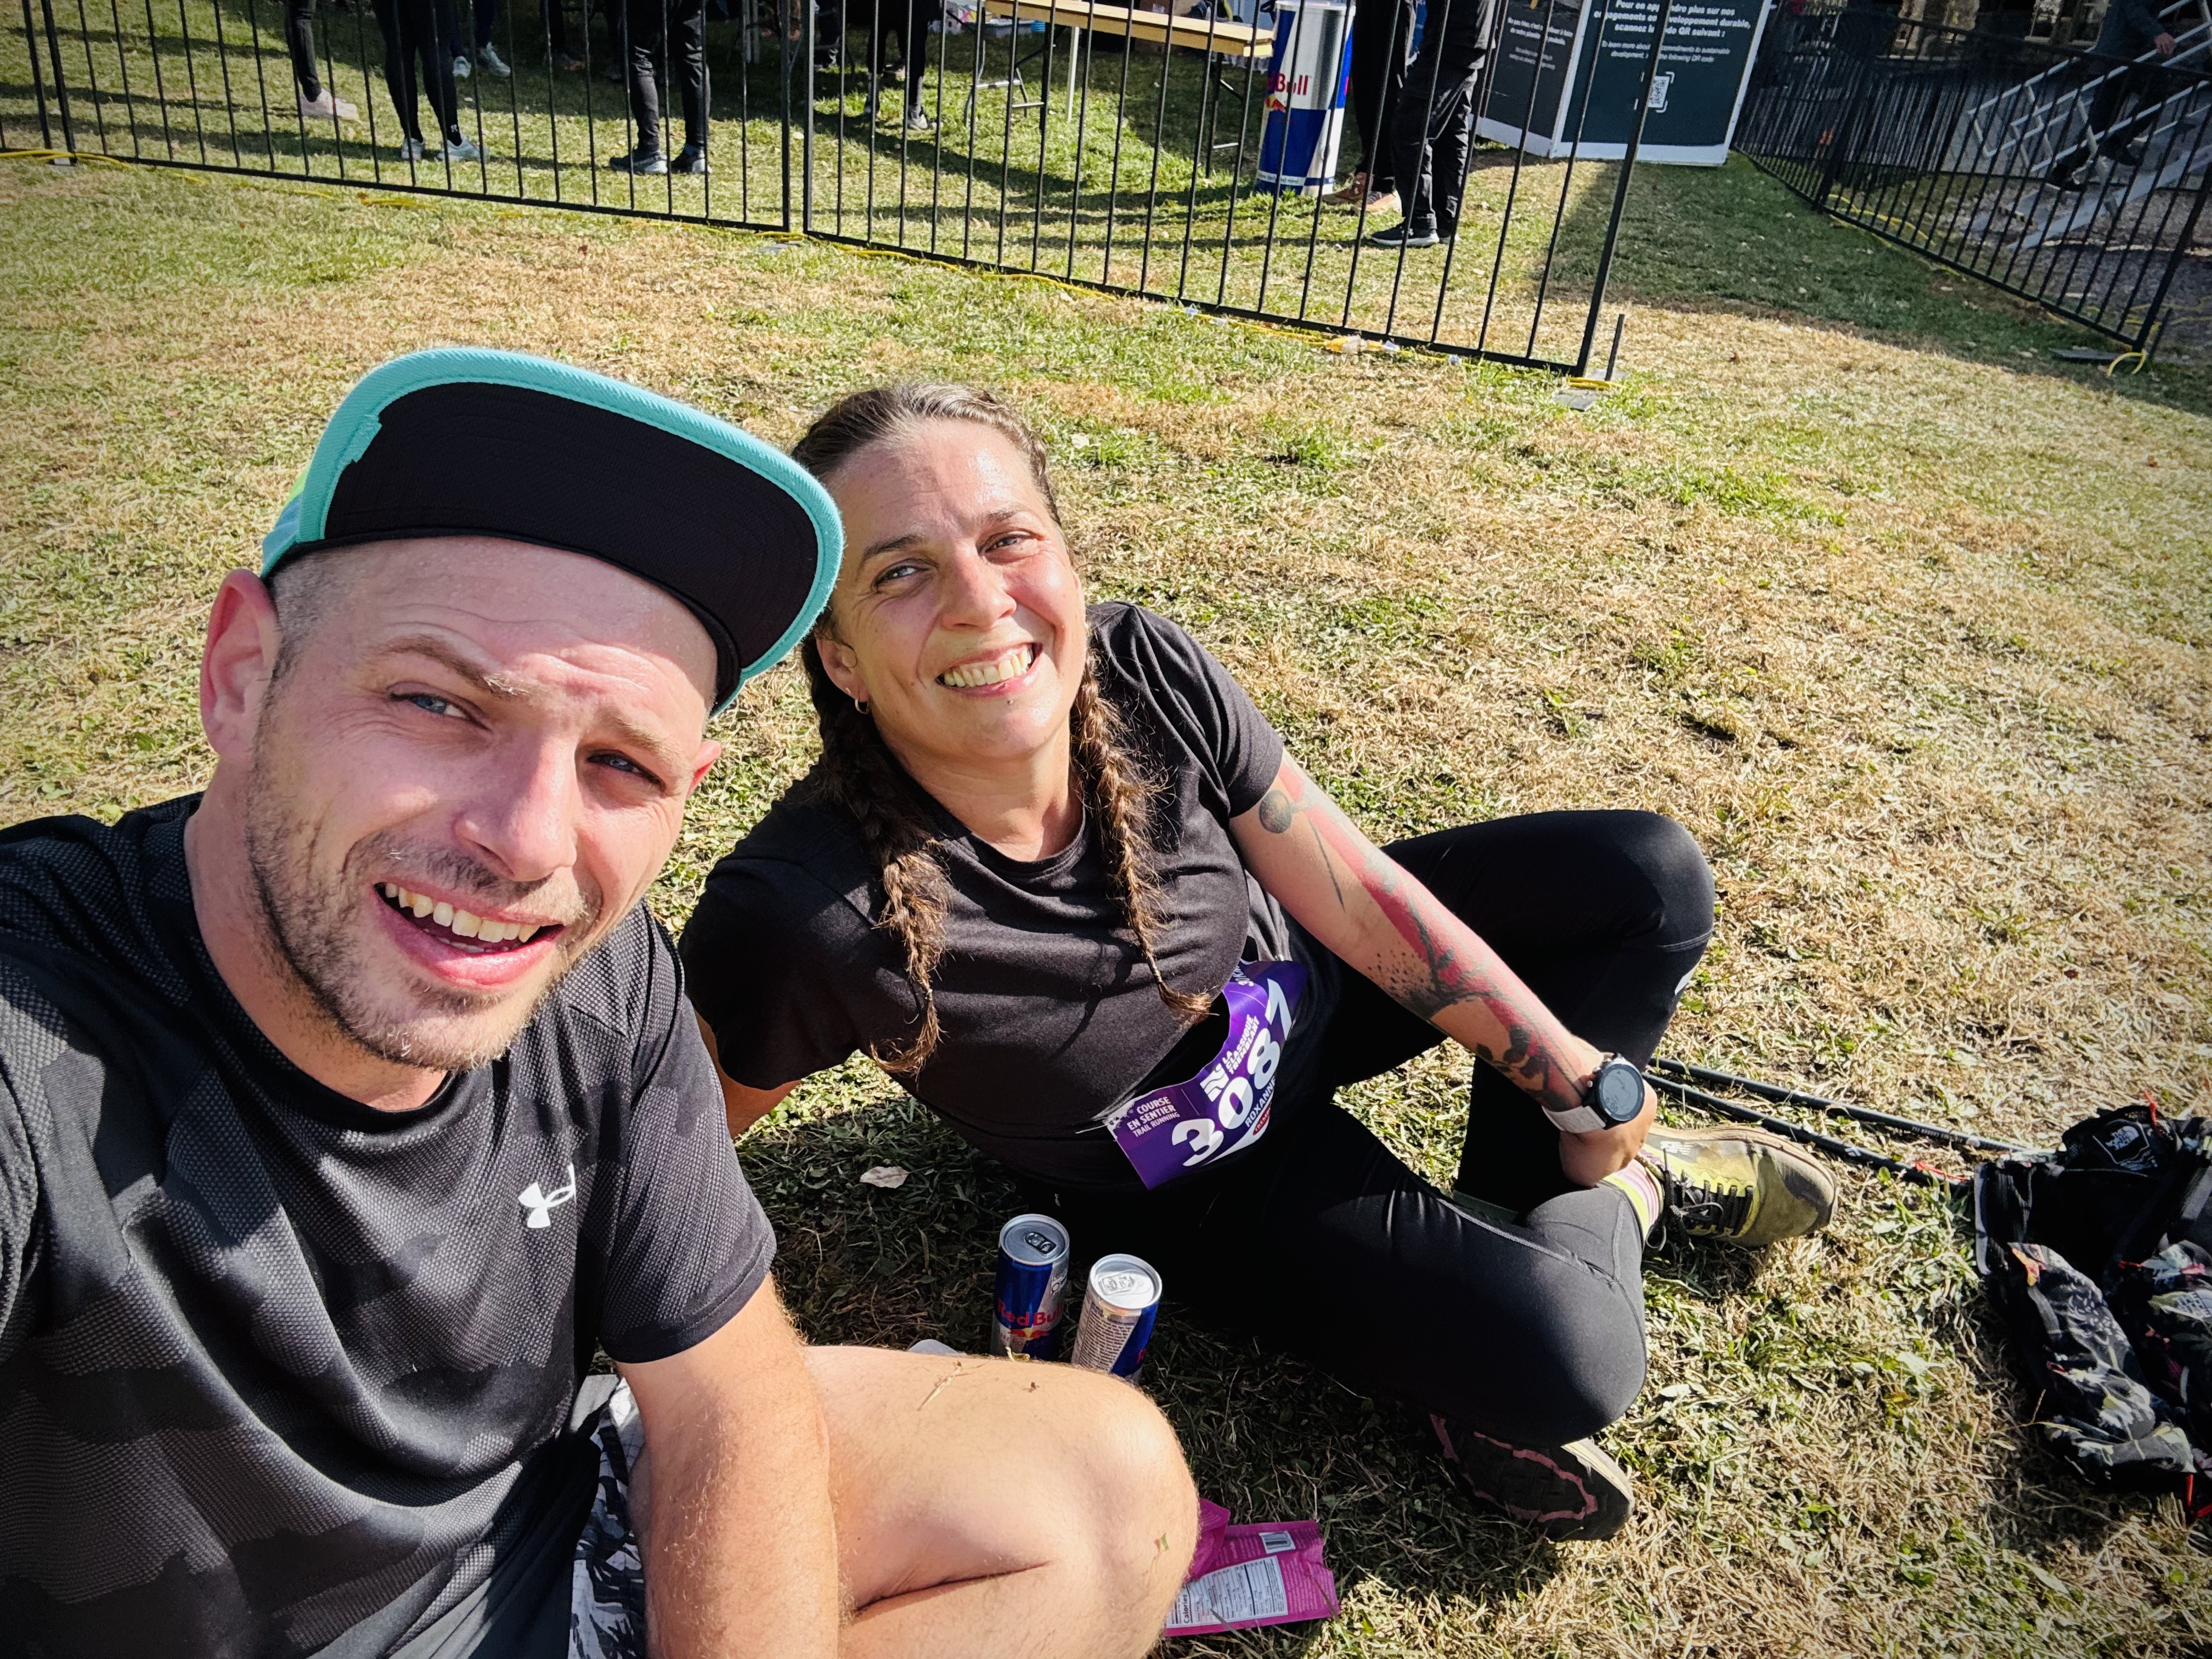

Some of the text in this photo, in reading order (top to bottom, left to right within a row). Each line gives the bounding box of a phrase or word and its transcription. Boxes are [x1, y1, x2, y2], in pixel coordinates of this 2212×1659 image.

[1616, 0, 1634, 9] Pour
[1687, 4, 1705, 15] plus
[1668, 15, 1718, 26] veloppement
[1678, 26, 1691, 35] QR
[1226, 1014, 1253, 1070] CLASSIQUE
[1229, 1016, 1260, 1074] TREMBLANT
[1222, 1051, 1233, 1064] LA
[1171, 978, 1292, 1166] 3087
[1127, 1104, 1176, 1130] EN SENTIER
[1137, 1097, 1171, 1114] COURSE
[1132, 1111, 1180, 1137] TRAIL RUNNING
[998, 1298, 1063, 1326] Red Bull
